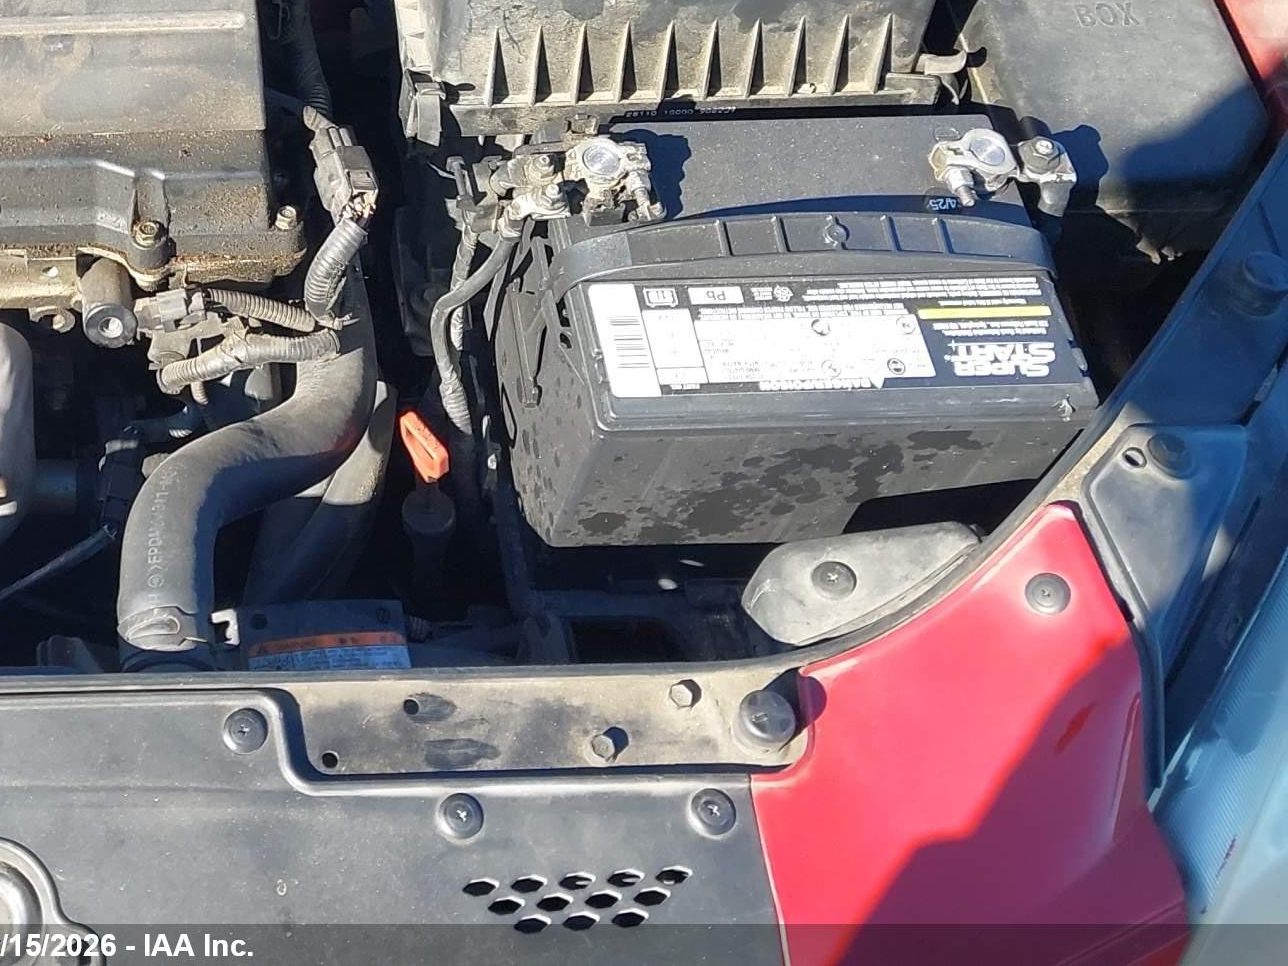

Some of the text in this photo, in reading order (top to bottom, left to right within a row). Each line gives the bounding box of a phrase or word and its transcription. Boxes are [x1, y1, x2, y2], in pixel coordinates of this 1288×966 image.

[1074, 1, 1141, 27] BOX
[706, 289, 727, 301] Pb
[950, 343, 1056, 364] START
[953, 360, 1051, 378] SUPER
